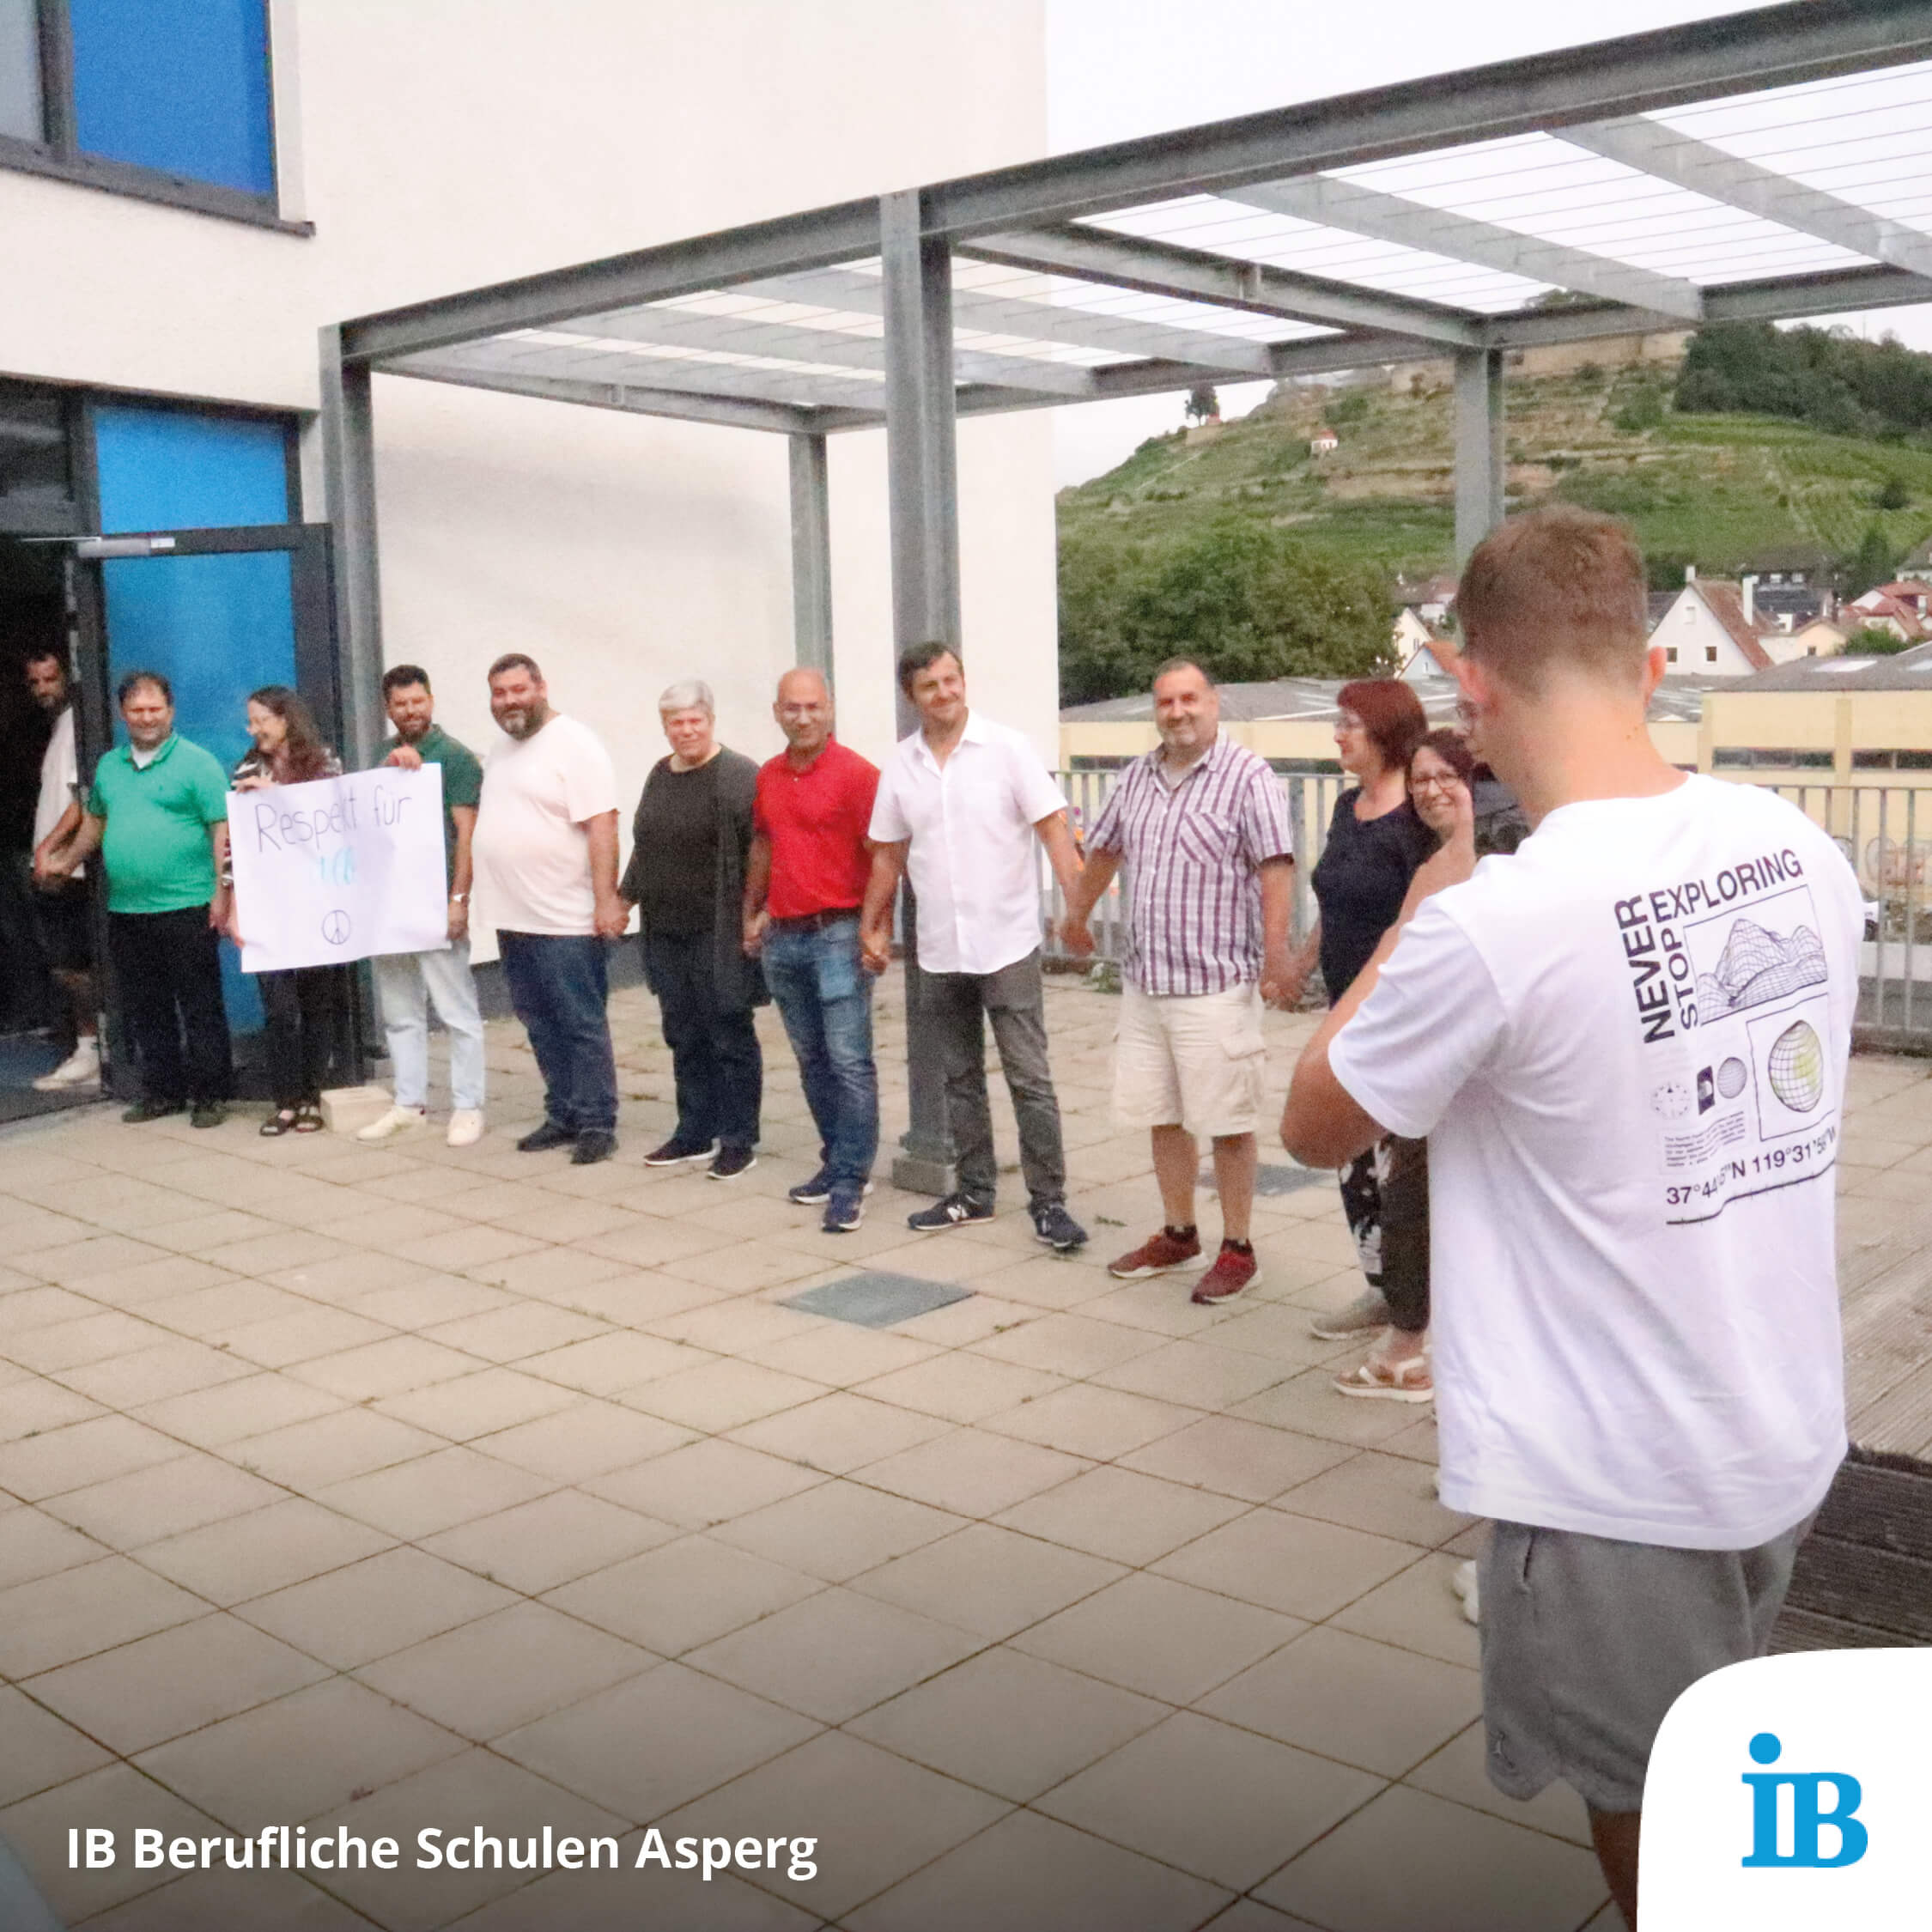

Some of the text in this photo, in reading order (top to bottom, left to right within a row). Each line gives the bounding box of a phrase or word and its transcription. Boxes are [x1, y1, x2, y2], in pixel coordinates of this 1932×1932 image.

[1649, 848, 1804, 924] EXPLORING
[1614, 894, 1675, 1044] NEVER
[1661, 927, 1698, 1030] STOP
